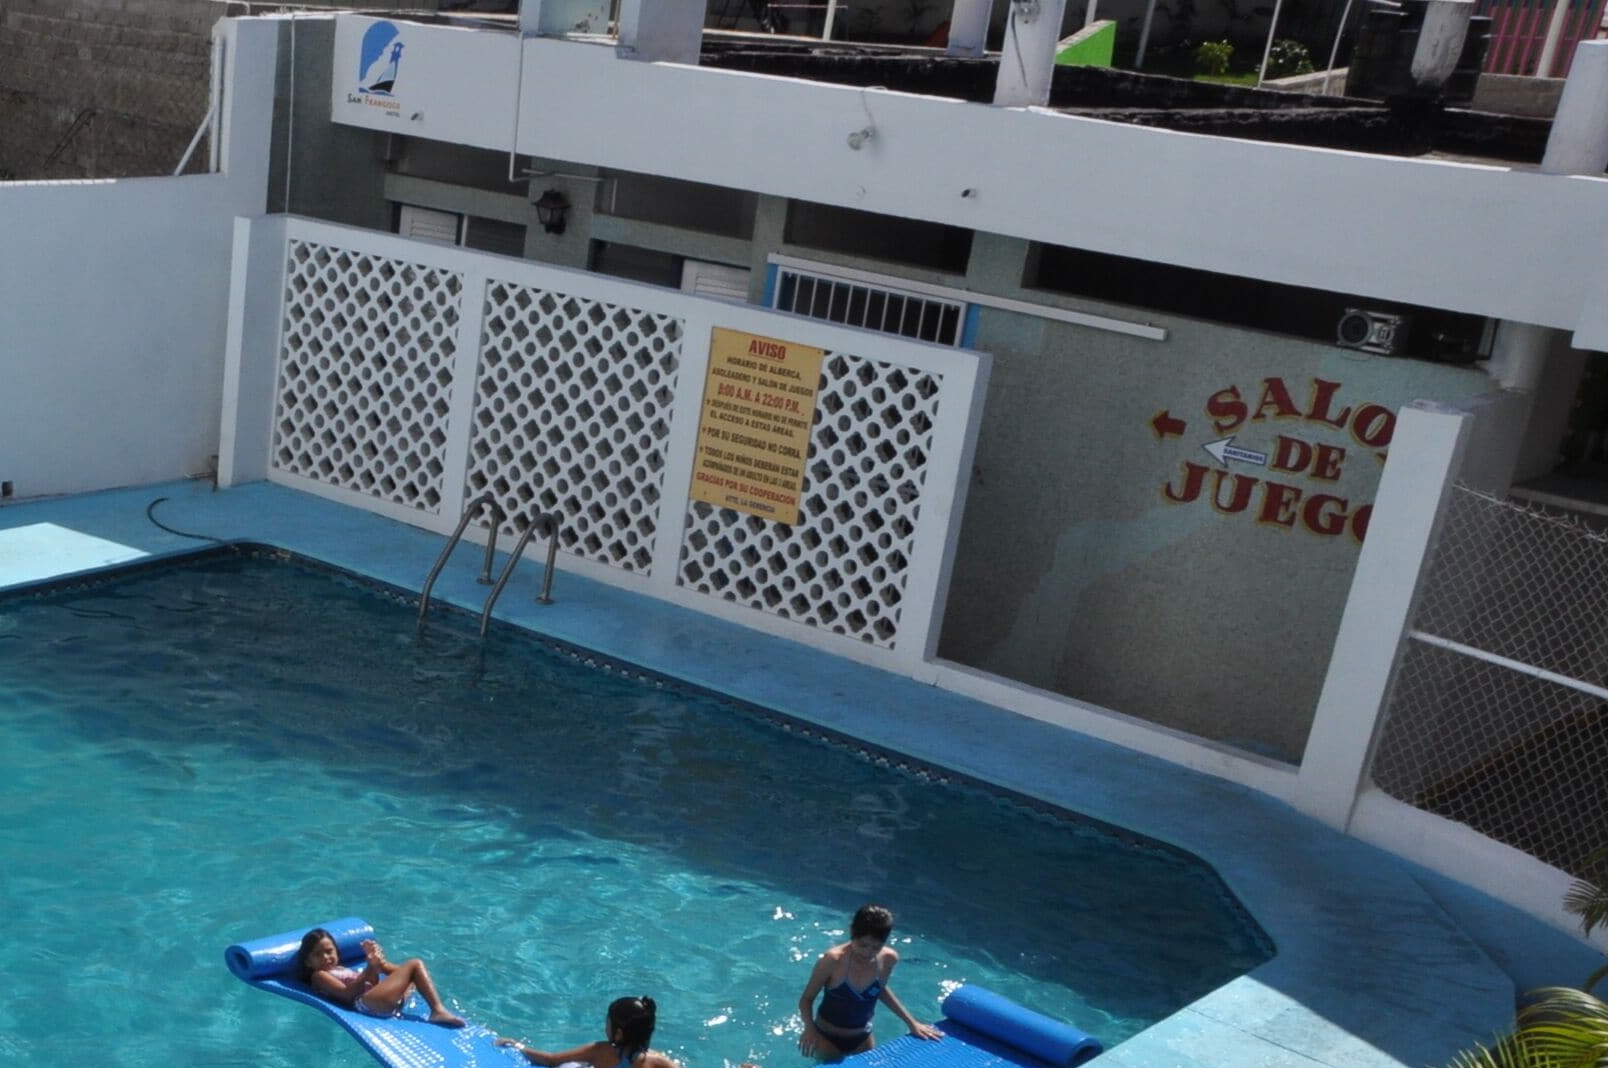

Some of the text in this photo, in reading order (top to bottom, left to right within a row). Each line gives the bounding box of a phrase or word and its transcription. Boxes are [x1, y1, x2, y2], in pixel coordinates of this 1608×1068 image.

[748, 339, 786, 360] AVISO
[727, 357, 757, 369] HORARIO
[758, 363, 767, 371] DE
[712, 368, 750, 382] ASOLEADERO
[779, 382, 786, 390] DE
[789, 385, 813, 397] JUEGOS
[754, 391, 760, 403] A
[763, 394, 784, 409] 22:00
[710, 409, 717, 418] EL
[720, 412, 744, 424] ACCESO
[745, 418, 749, 426] A
[751, 420, 770, 431] ESTAS
[740, 406, 751, 414] ESTE
[752, 409, 772, 420] HORARIO
[772, 413, 780, 422] NO
[788, 418, 808, 429] PERMITE
[1204, 376, 1397, 452] SALO
[708, 427, 720, 438] POR
[721, 430, 730, 440] SU
[732, 433, 766, 449] SEGURIDAD
[767, 441, 776, 452] NO
[705, 447, 722, 458] TODOS
[723, 450, 734, 461] LOS
[781, 466, 799, 477] ESTAR
[1269, 434, 1347, 482] DE
[696, 472, 723, 486] GRACIAS
[725, 480, 737, 490] POR
[738, 482, 748, 493] SU
